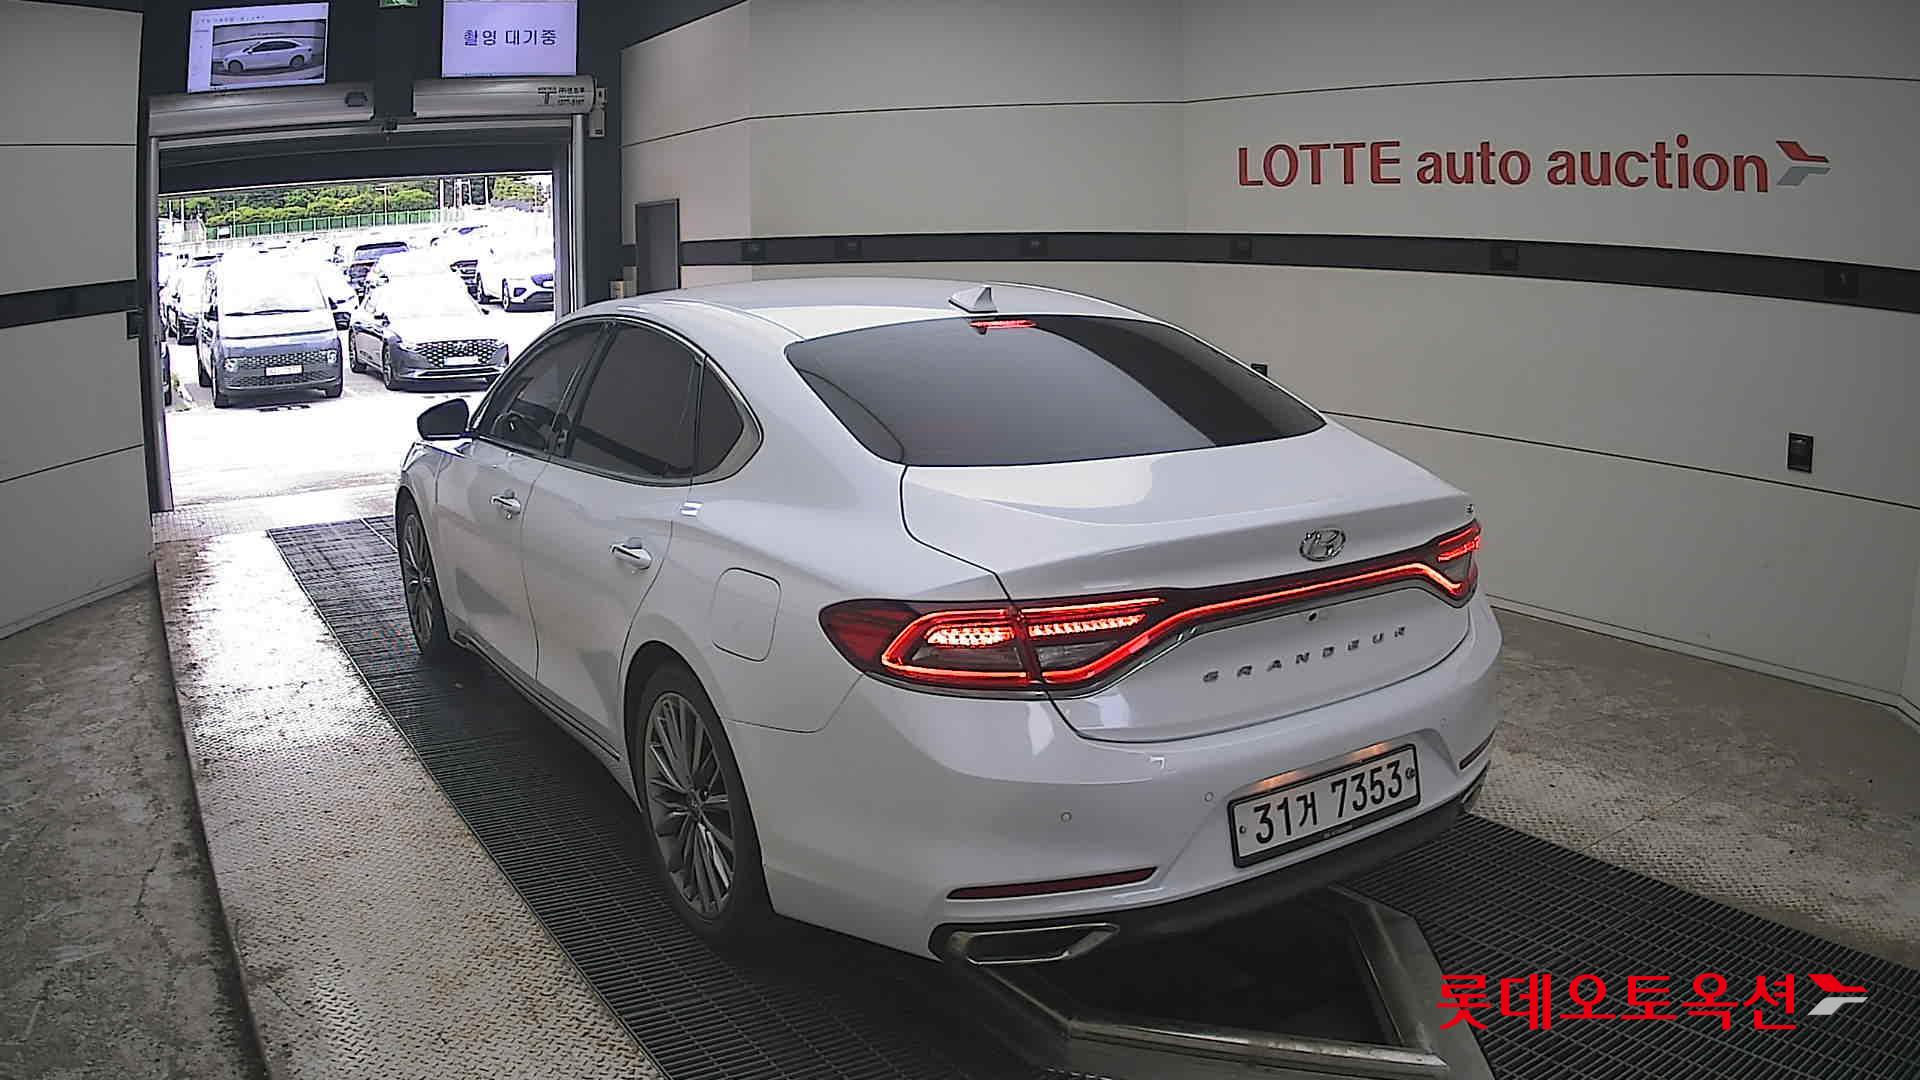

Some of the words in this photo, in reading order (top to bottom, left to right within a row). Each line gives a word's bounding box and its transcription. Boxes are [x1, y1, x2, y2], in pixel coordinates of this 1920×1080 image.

[505, 29, 557, 46] 대기중
[1238, 140, 1401, 187] LOTTE
[1416, 141, 1532, 186] auto
[1546, 133, 1770, 193] auction
[1203, 626, 1407, 683] GRANDEUR
[1253, 791, 1318, 844] 31거
[1331, 759, 1403, 818] 7353
